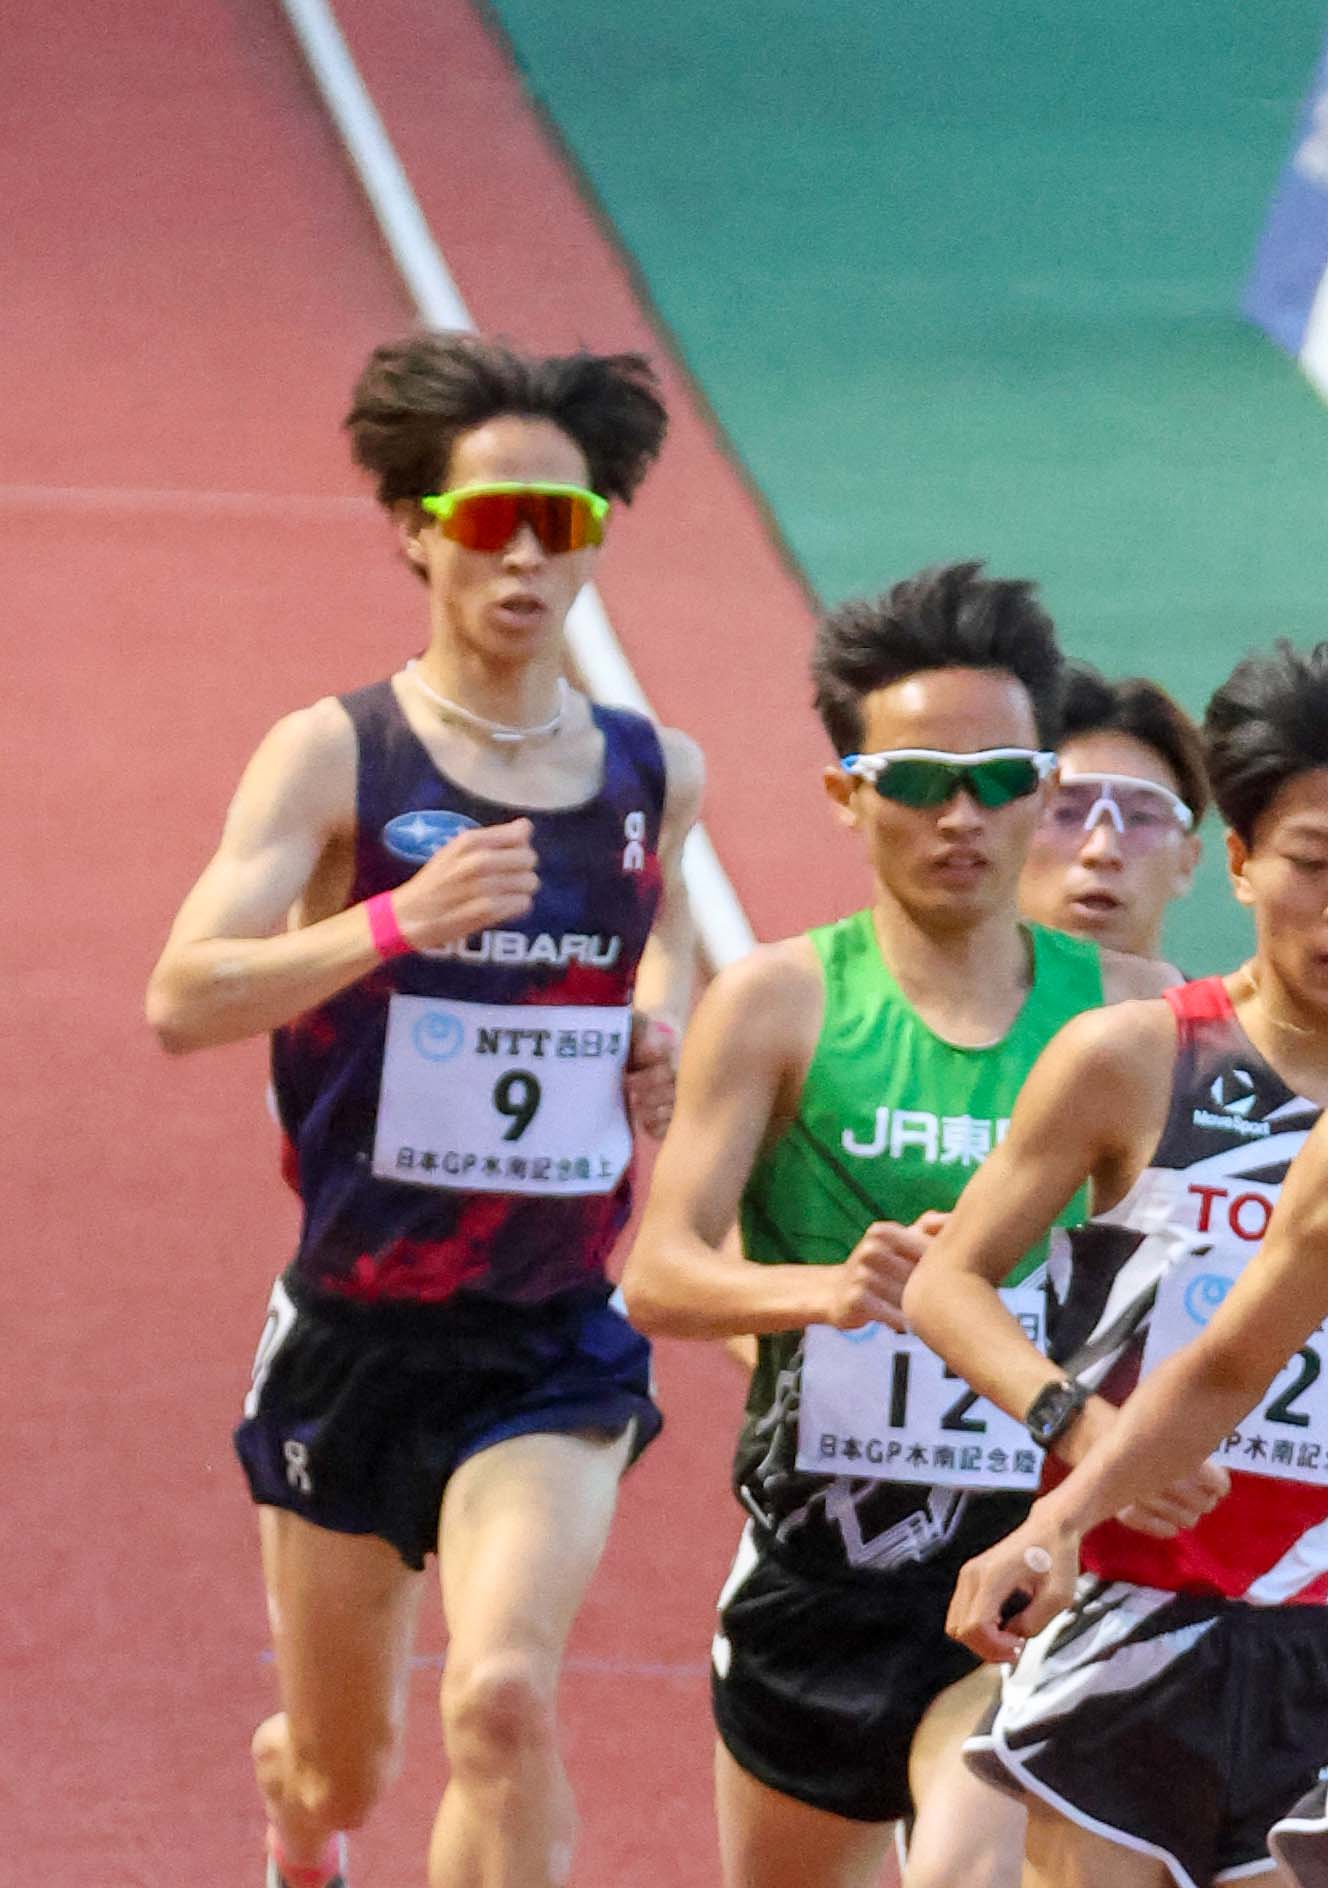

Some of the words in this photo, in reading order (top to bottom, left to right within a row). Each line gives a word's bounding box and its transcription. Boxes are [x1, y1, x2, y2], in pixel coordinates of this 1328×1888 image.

[476, 1027, 550, 1057] NTT
[493, 1068, 542, 1141] 9
[1264, 1345, 1322, 1427] 2
